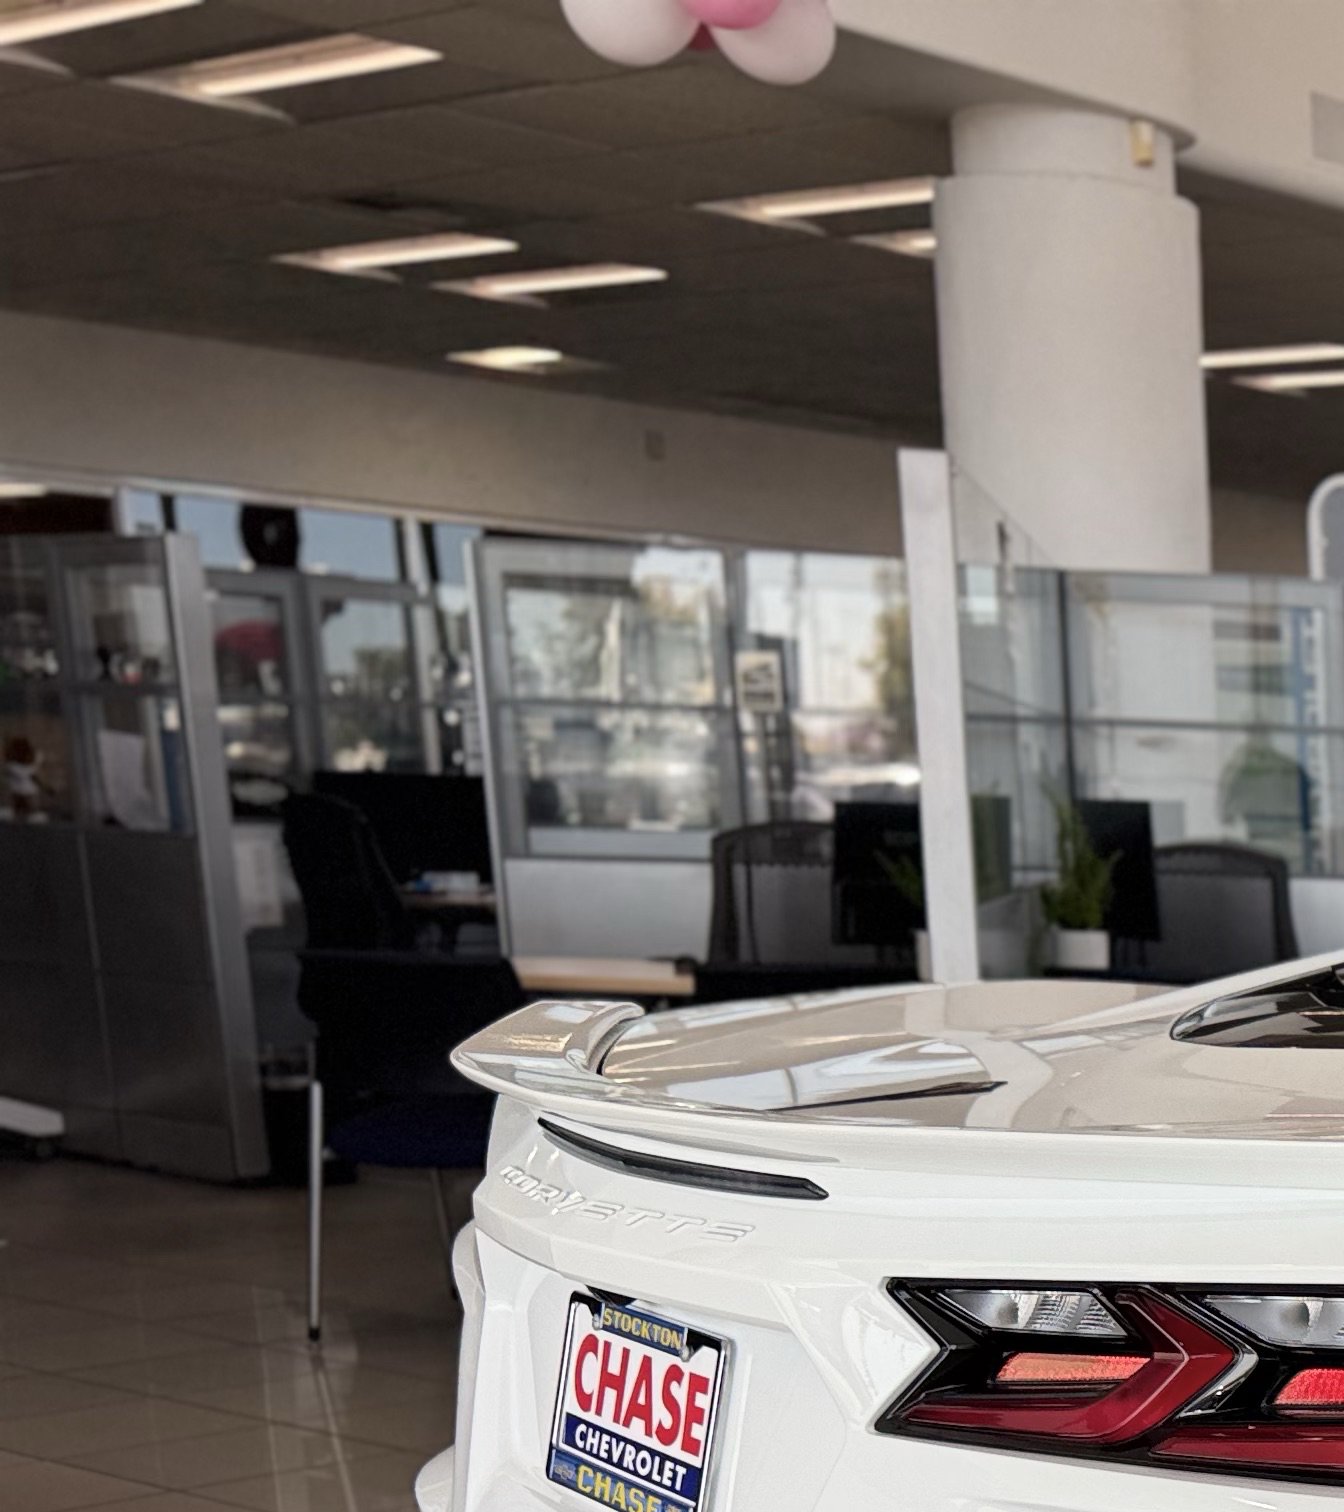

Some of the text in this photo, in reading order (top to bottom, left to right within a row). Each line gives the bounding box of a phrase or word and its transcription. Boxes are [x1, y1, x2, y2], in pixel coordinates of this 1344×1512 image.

[499, 1165, 756, 1243] CORVETTE
[602, 1307, 684, 1350] STOCKTON
[574, 1333, 711, 1458] CHASE
[574, 1423, 688, 1492] CHEVROLET
